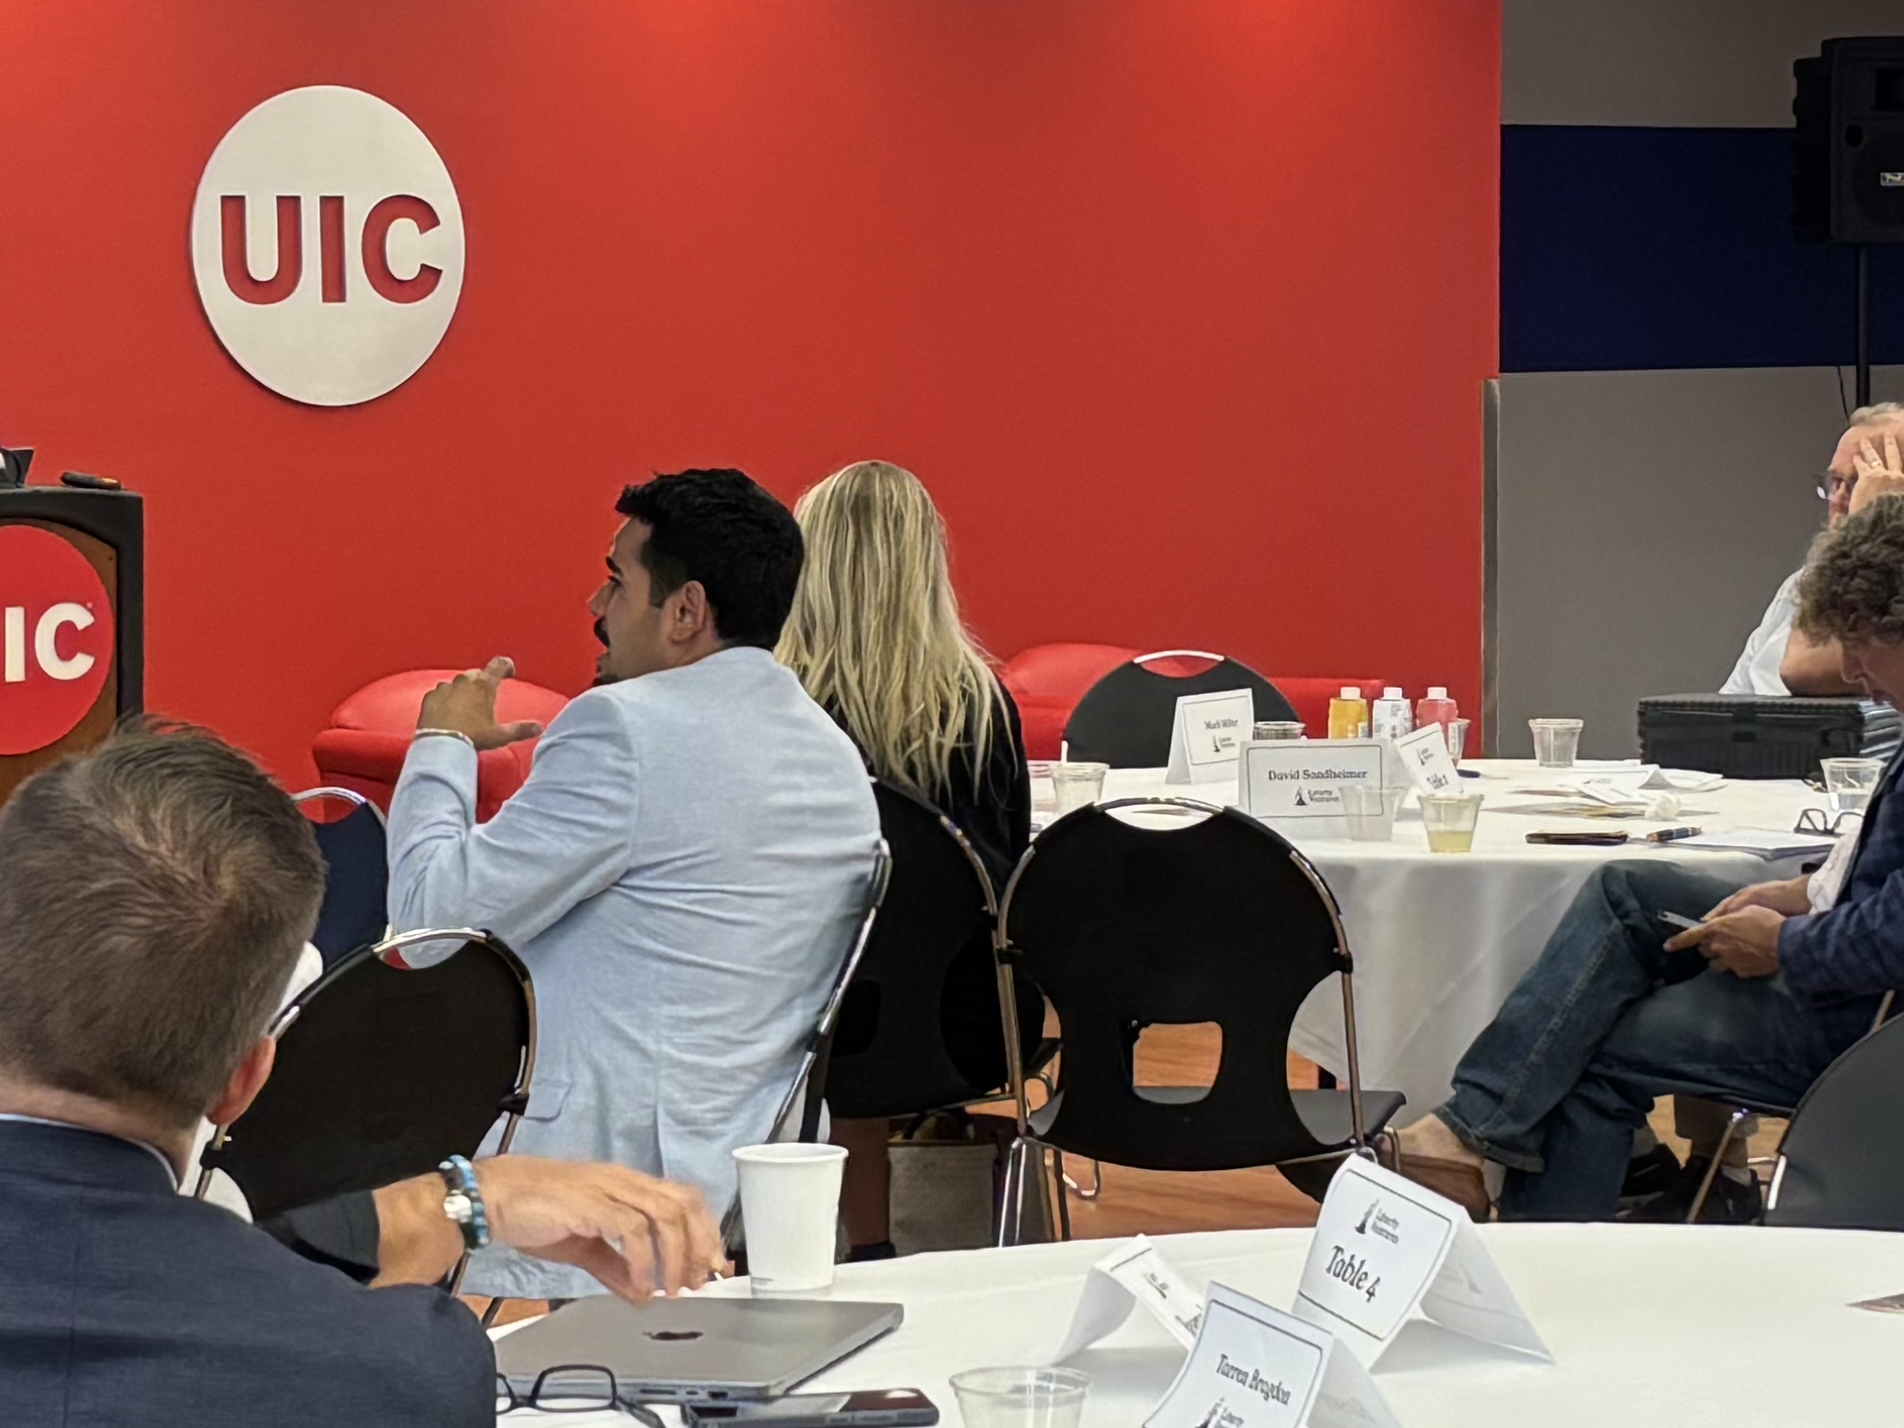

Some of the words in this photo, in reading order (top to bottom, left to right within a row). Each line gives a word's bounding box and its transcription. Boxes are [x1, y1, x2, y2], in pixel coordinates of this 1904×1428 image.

[220, 193, 443, 305] UIC
[1268, 769, 1300, 781] David
[1325, 1244, 1369, 1291] Table
[1366, 1276, 1381, 1303] 4
